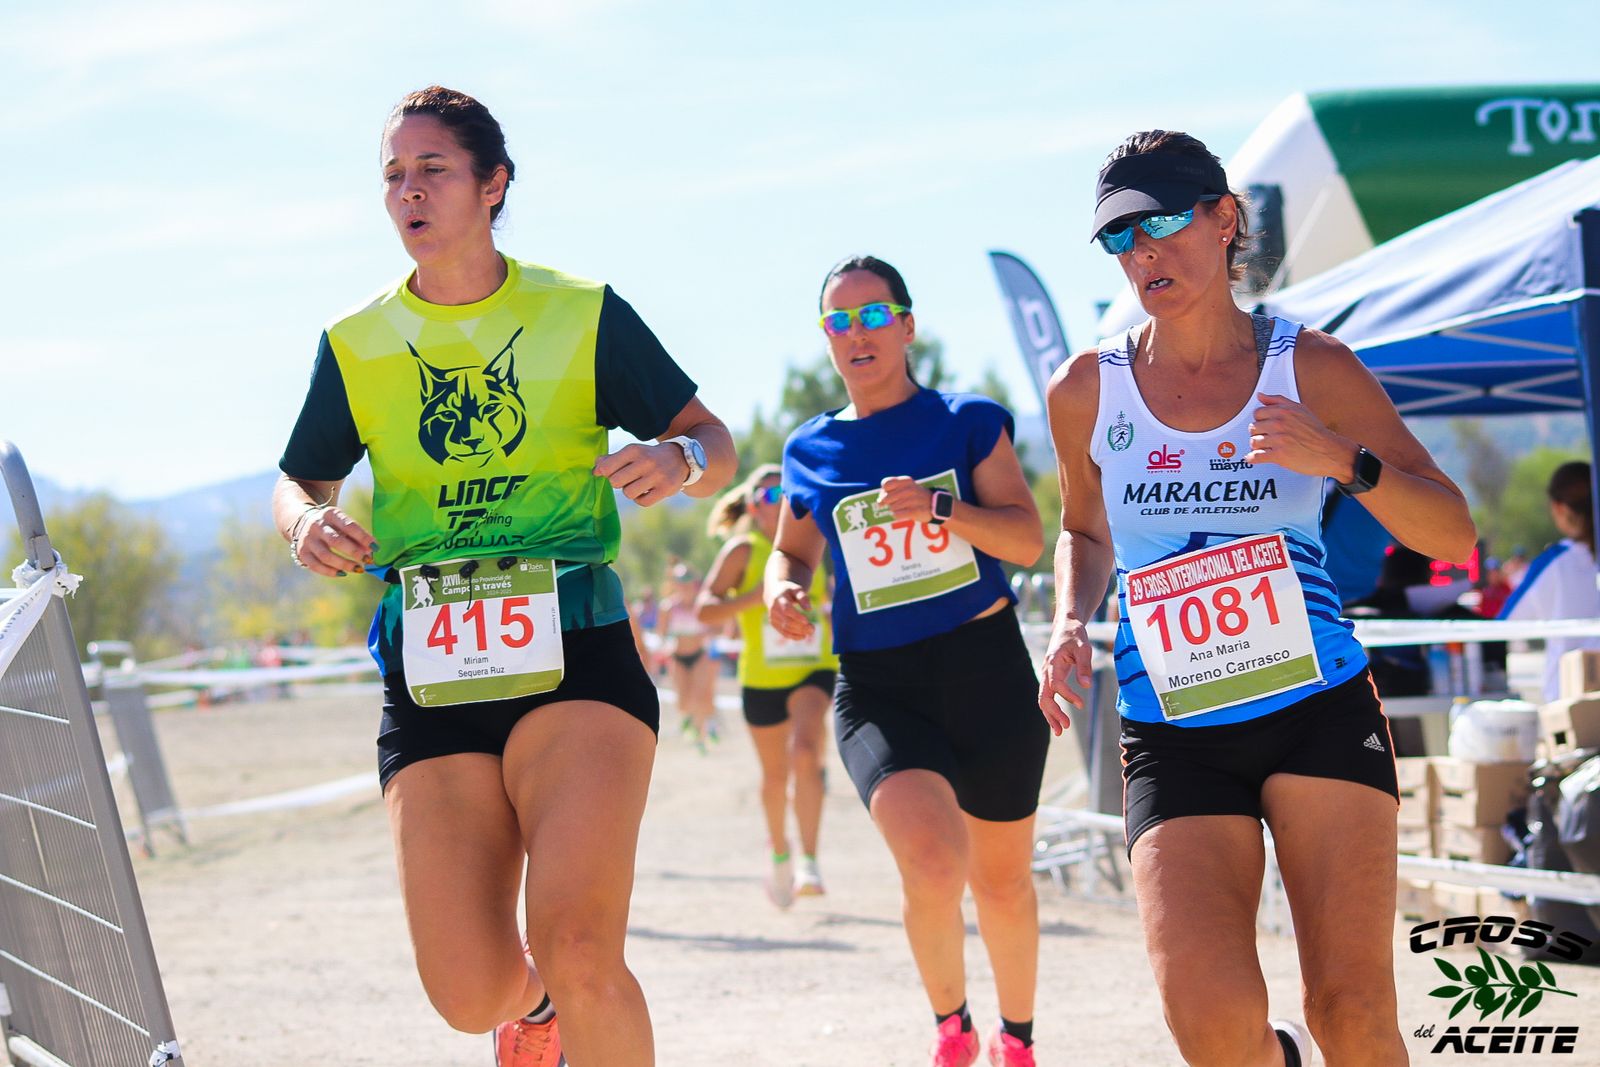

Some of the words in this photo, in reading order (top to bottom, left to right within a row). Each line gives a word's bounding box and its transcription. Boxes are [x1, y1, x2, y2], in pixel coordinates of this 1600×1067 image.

[1123, 478, 1278, 504] MARACENA
[1140, 507, 1170, 516] CLUB
[1173, 507, 1188, 515] DE
[1192, 505, 1260, 515] ATLETISMO
[864, 518, 950, 568] 379
[1132, 574, 1144, 602] 39
[1144, 570, 1170, 597] CROSS
[1168, 552, 1234, 590] INTERNACIONAL
[1231, 548, 1251, 576] DEL
[1252, 541, 1282, 570] ACEITE
[475, 584, 480, 592] a
[483, 579, 512, 591] través
[427, 596, 535, 655] 415
[1146, 576, 1281, 653] 1081
[464, 656, 489, 665] Miriam
[1189, 650, 1214, 663] Ana
[1216, 640, 1251, 657] Maria
[458, 668, 489, 679] Sequera
[490, 666, 505, 675] Ruz
[1168, 668, 1223, 690] Moreno
[1226, 649, 1291, 675] Carrasco
